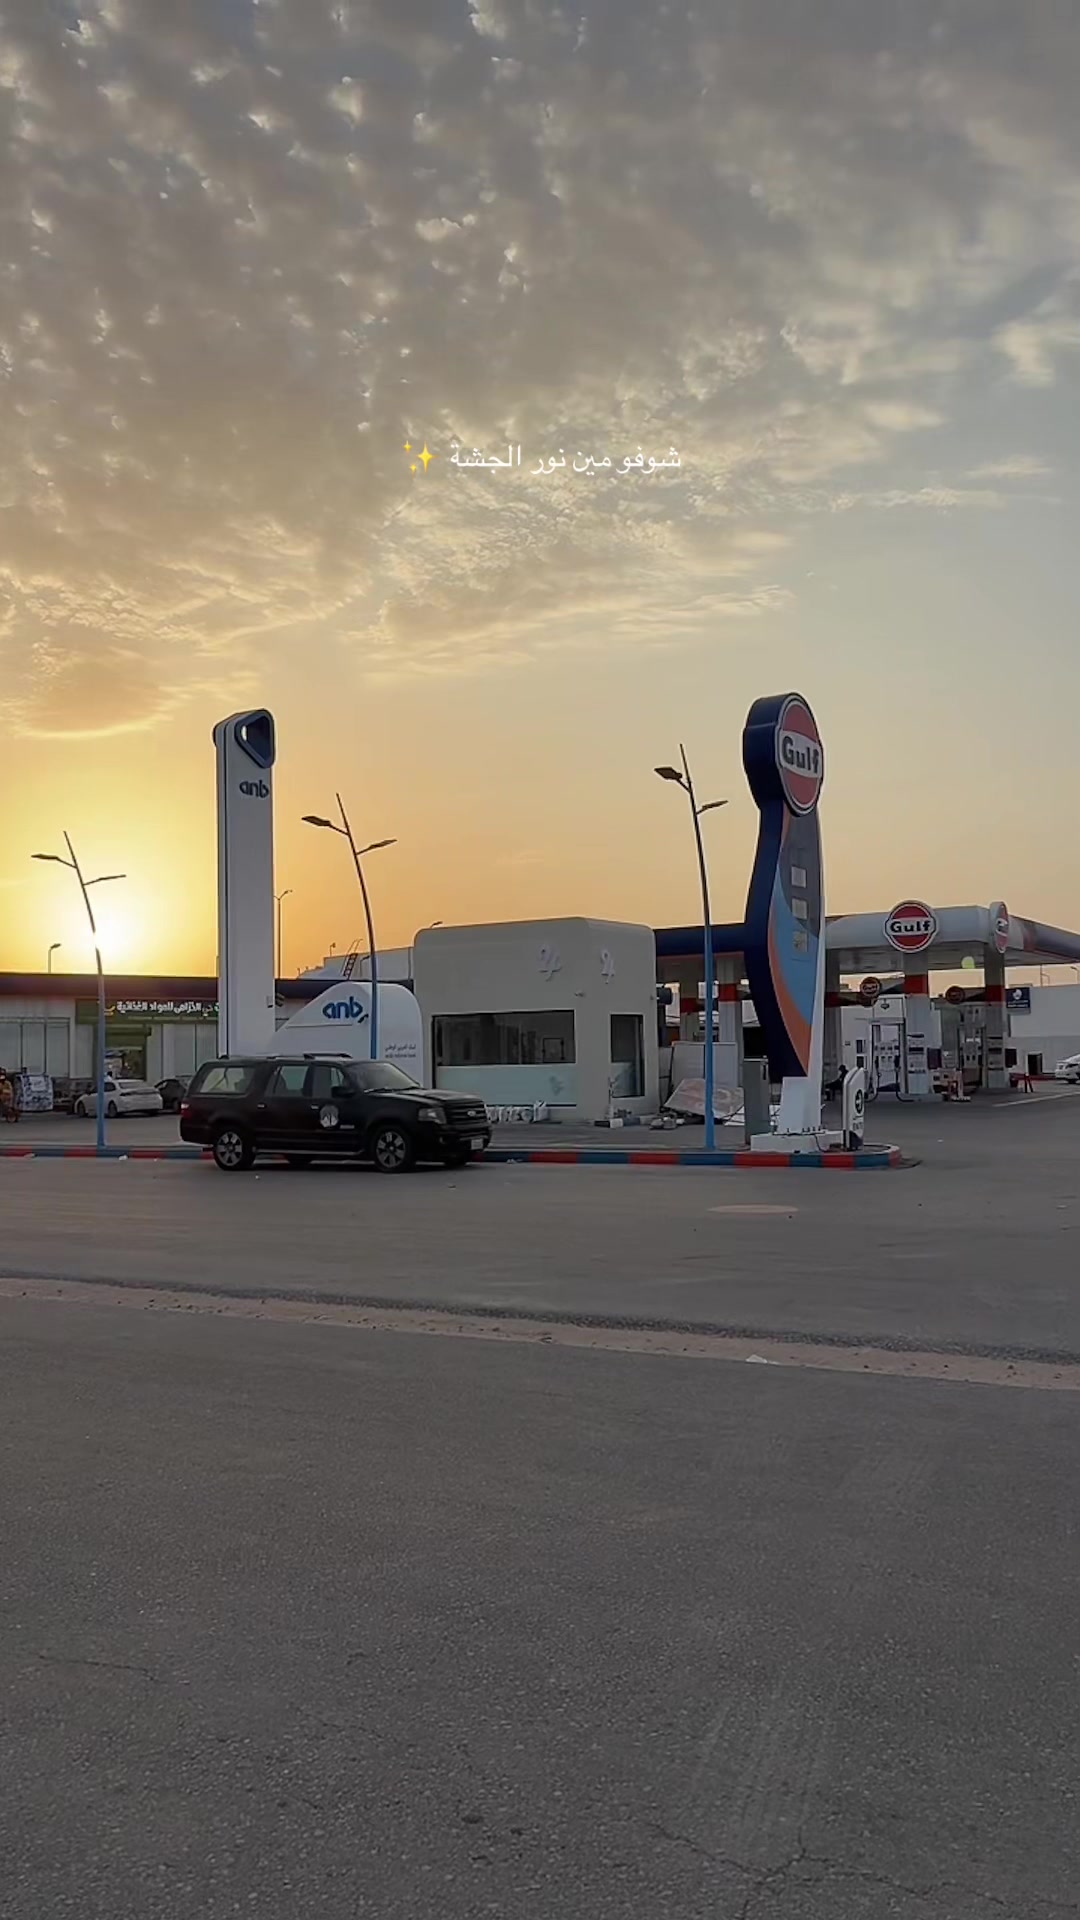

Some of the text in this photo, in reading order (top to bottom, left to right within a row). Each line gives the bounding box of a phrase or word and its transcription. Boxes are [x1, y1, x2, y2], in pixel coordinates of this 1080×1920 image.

[782, 735, 819, 774] Gulf
[239, 780, 269, 798] anb
[890, 920, 931, 933] Gulf
[322, 996, 363, 1018] anb
